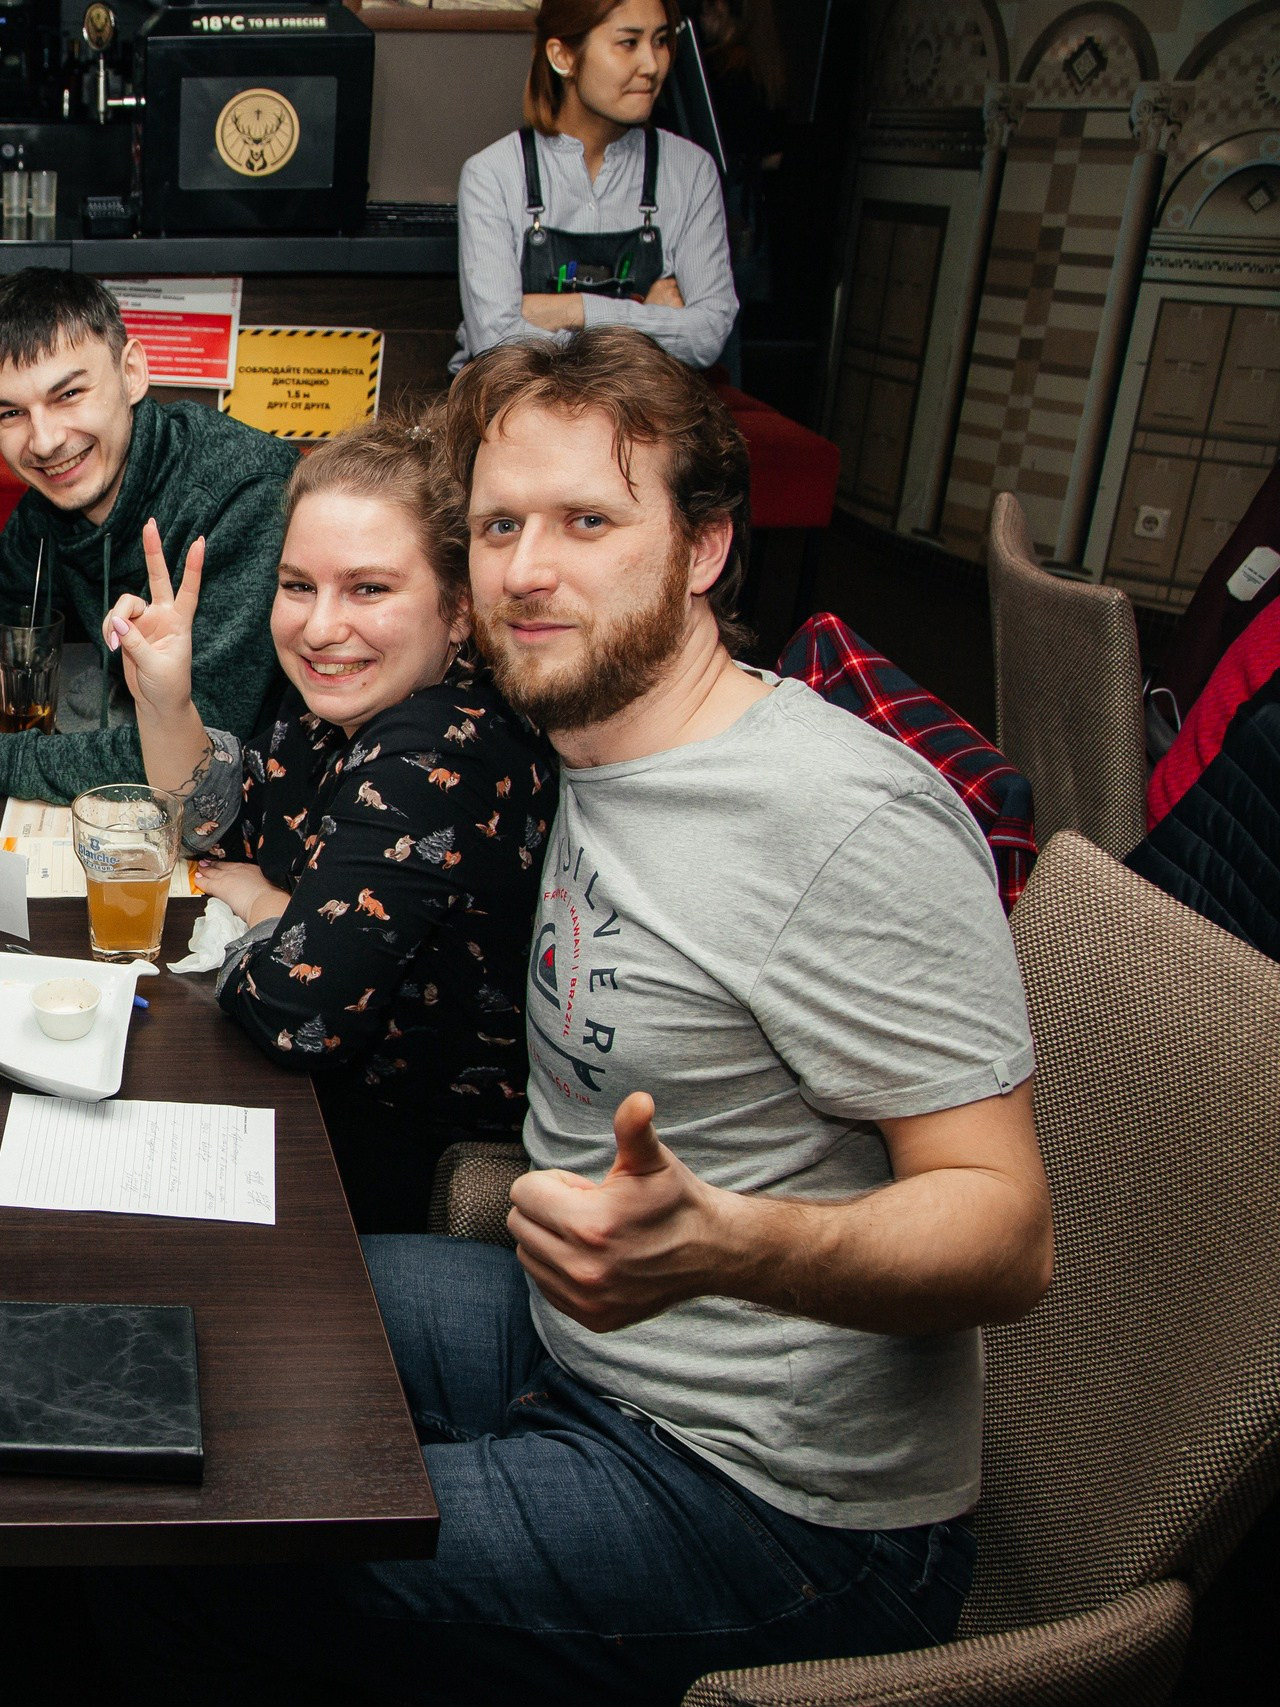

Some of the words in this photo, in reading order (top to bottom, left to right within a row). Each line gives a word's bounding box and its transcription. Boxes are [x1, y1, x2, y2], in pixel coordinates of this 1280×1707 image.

[192, 15, 245, 31] -18°C
[248, 18, 264, 28] TO
[265, 17, 280, 28] BE
[282, 17, 326, 28] PRECISE
[238, 365, 301, 375] СОБЛЮДАЙТЕ
[303, 366, 365, 375] ПОЖАЛУЙСТА
[272, 377, 329, 386] ДИСТАНЦИЮ
[267, 401, 288, 410] ДРУГ
[304, 402, 331, 411] ДРУГА
[78, 843, 119, 864] Blanche
[562, 977, 578, 1038] BRAZIL
